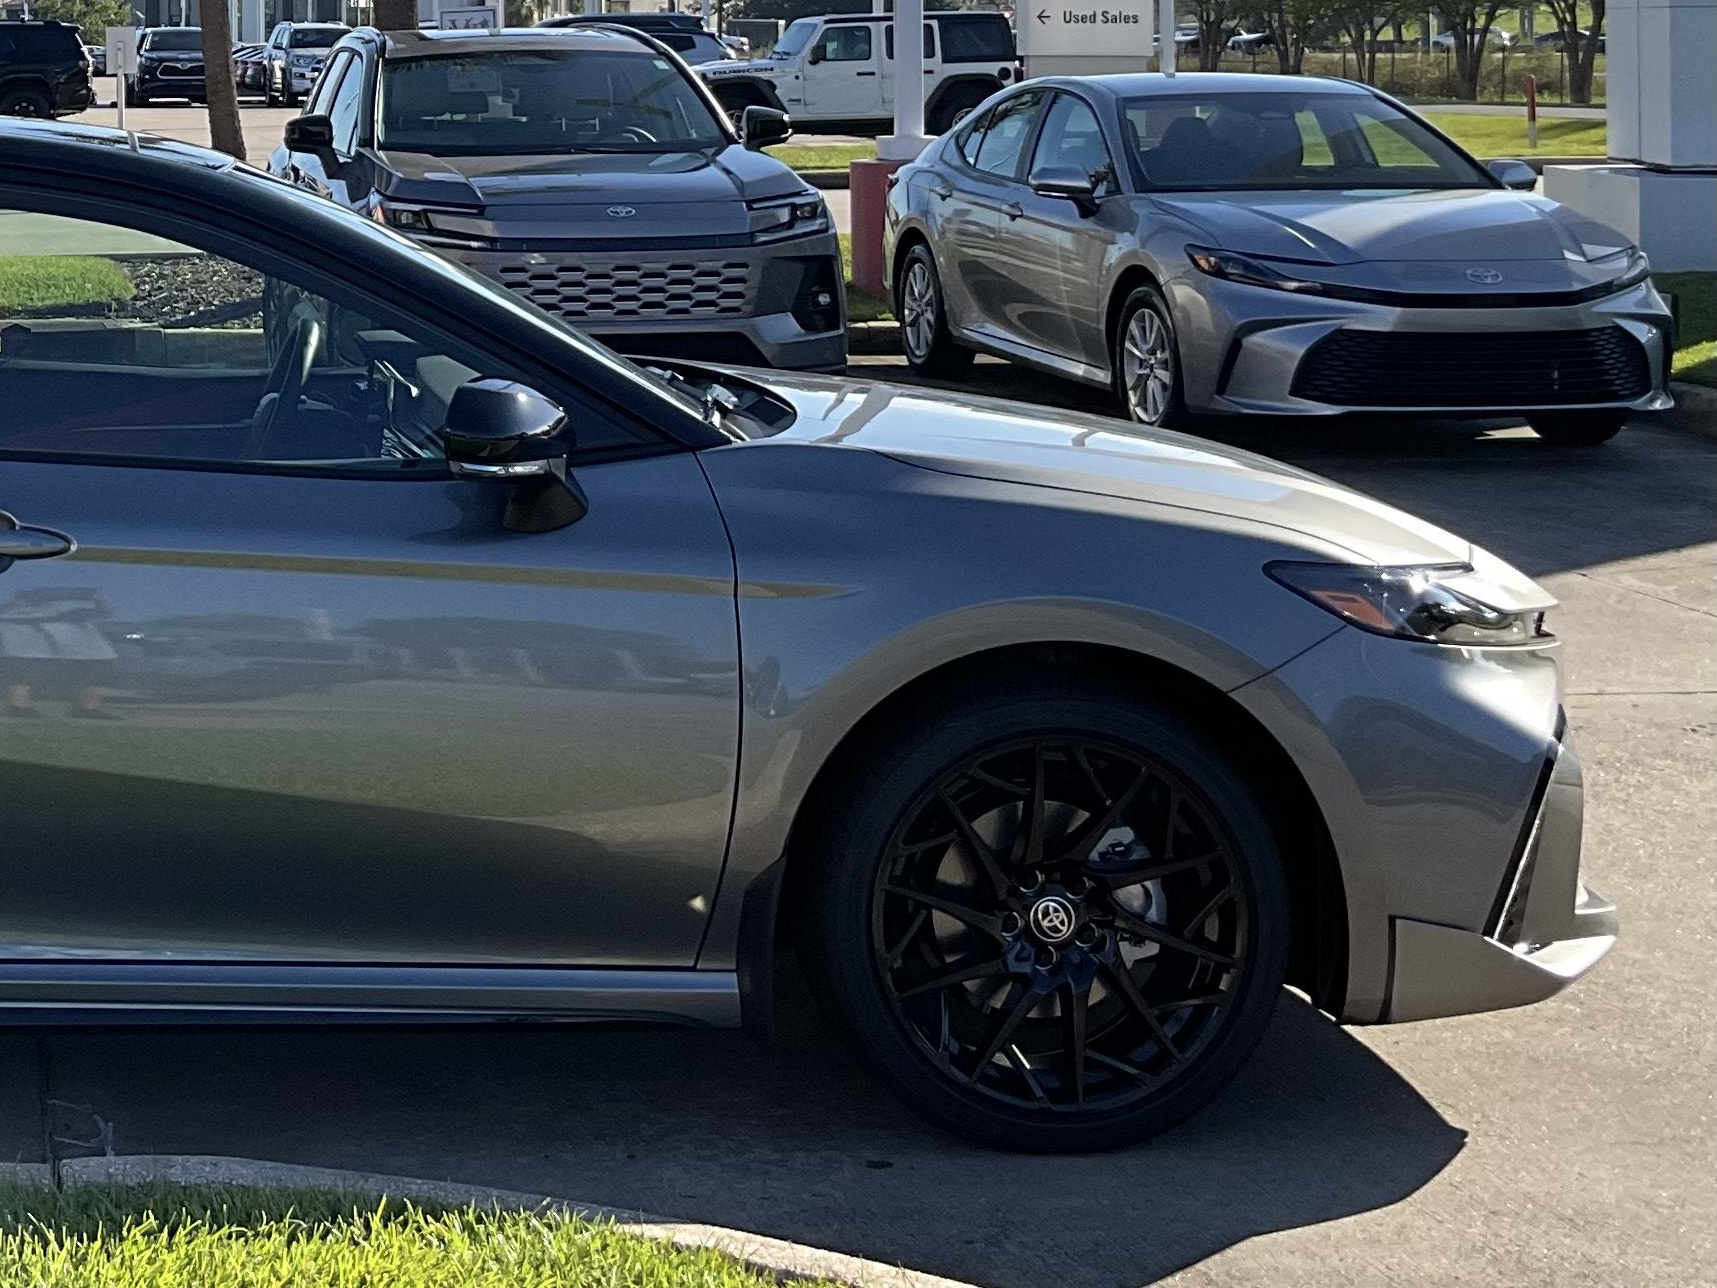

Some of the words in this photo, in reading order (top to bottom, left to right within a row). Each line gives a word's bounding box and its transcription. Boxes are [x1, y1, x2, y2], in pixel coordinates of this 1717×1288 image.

[1063, 10, 1097, 24] Used
[1100, 10, 1139, 24] Sales
[713, 67, 775, 76] RUBICON
